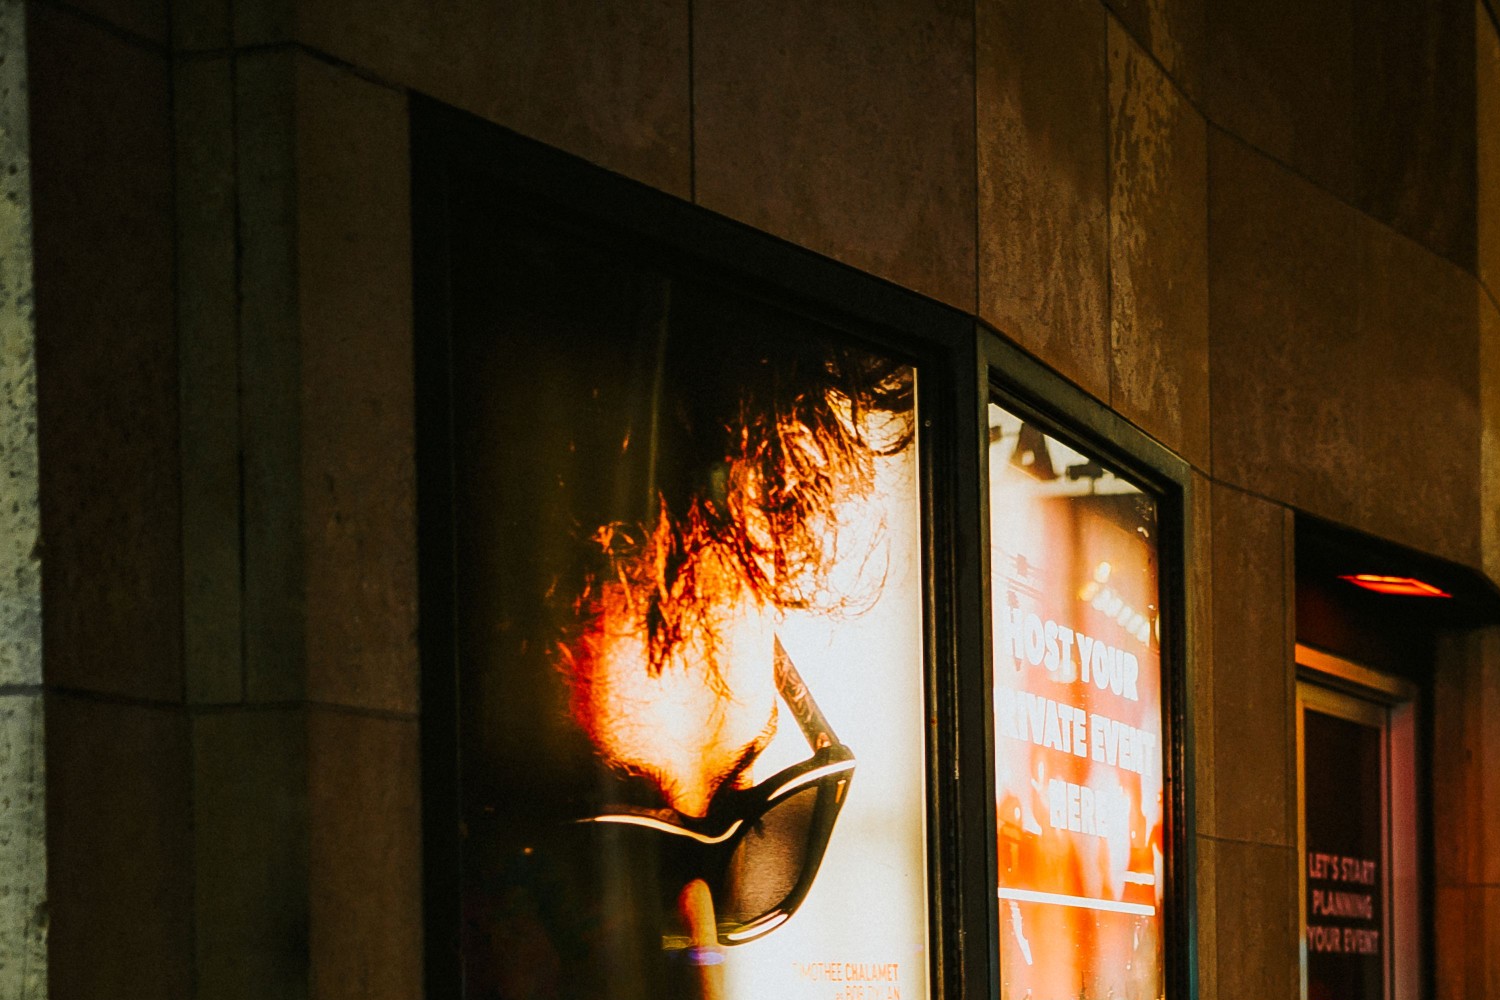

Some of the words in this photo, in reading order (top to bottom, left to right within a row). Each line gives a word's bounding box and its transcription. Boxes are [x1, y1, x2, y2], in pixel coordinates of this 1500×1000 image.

[1005, 607, 1074, 676] HOST
[1076, 632, 1139, 701] YOUR
[1049, 777, 1111, 839] HERE
